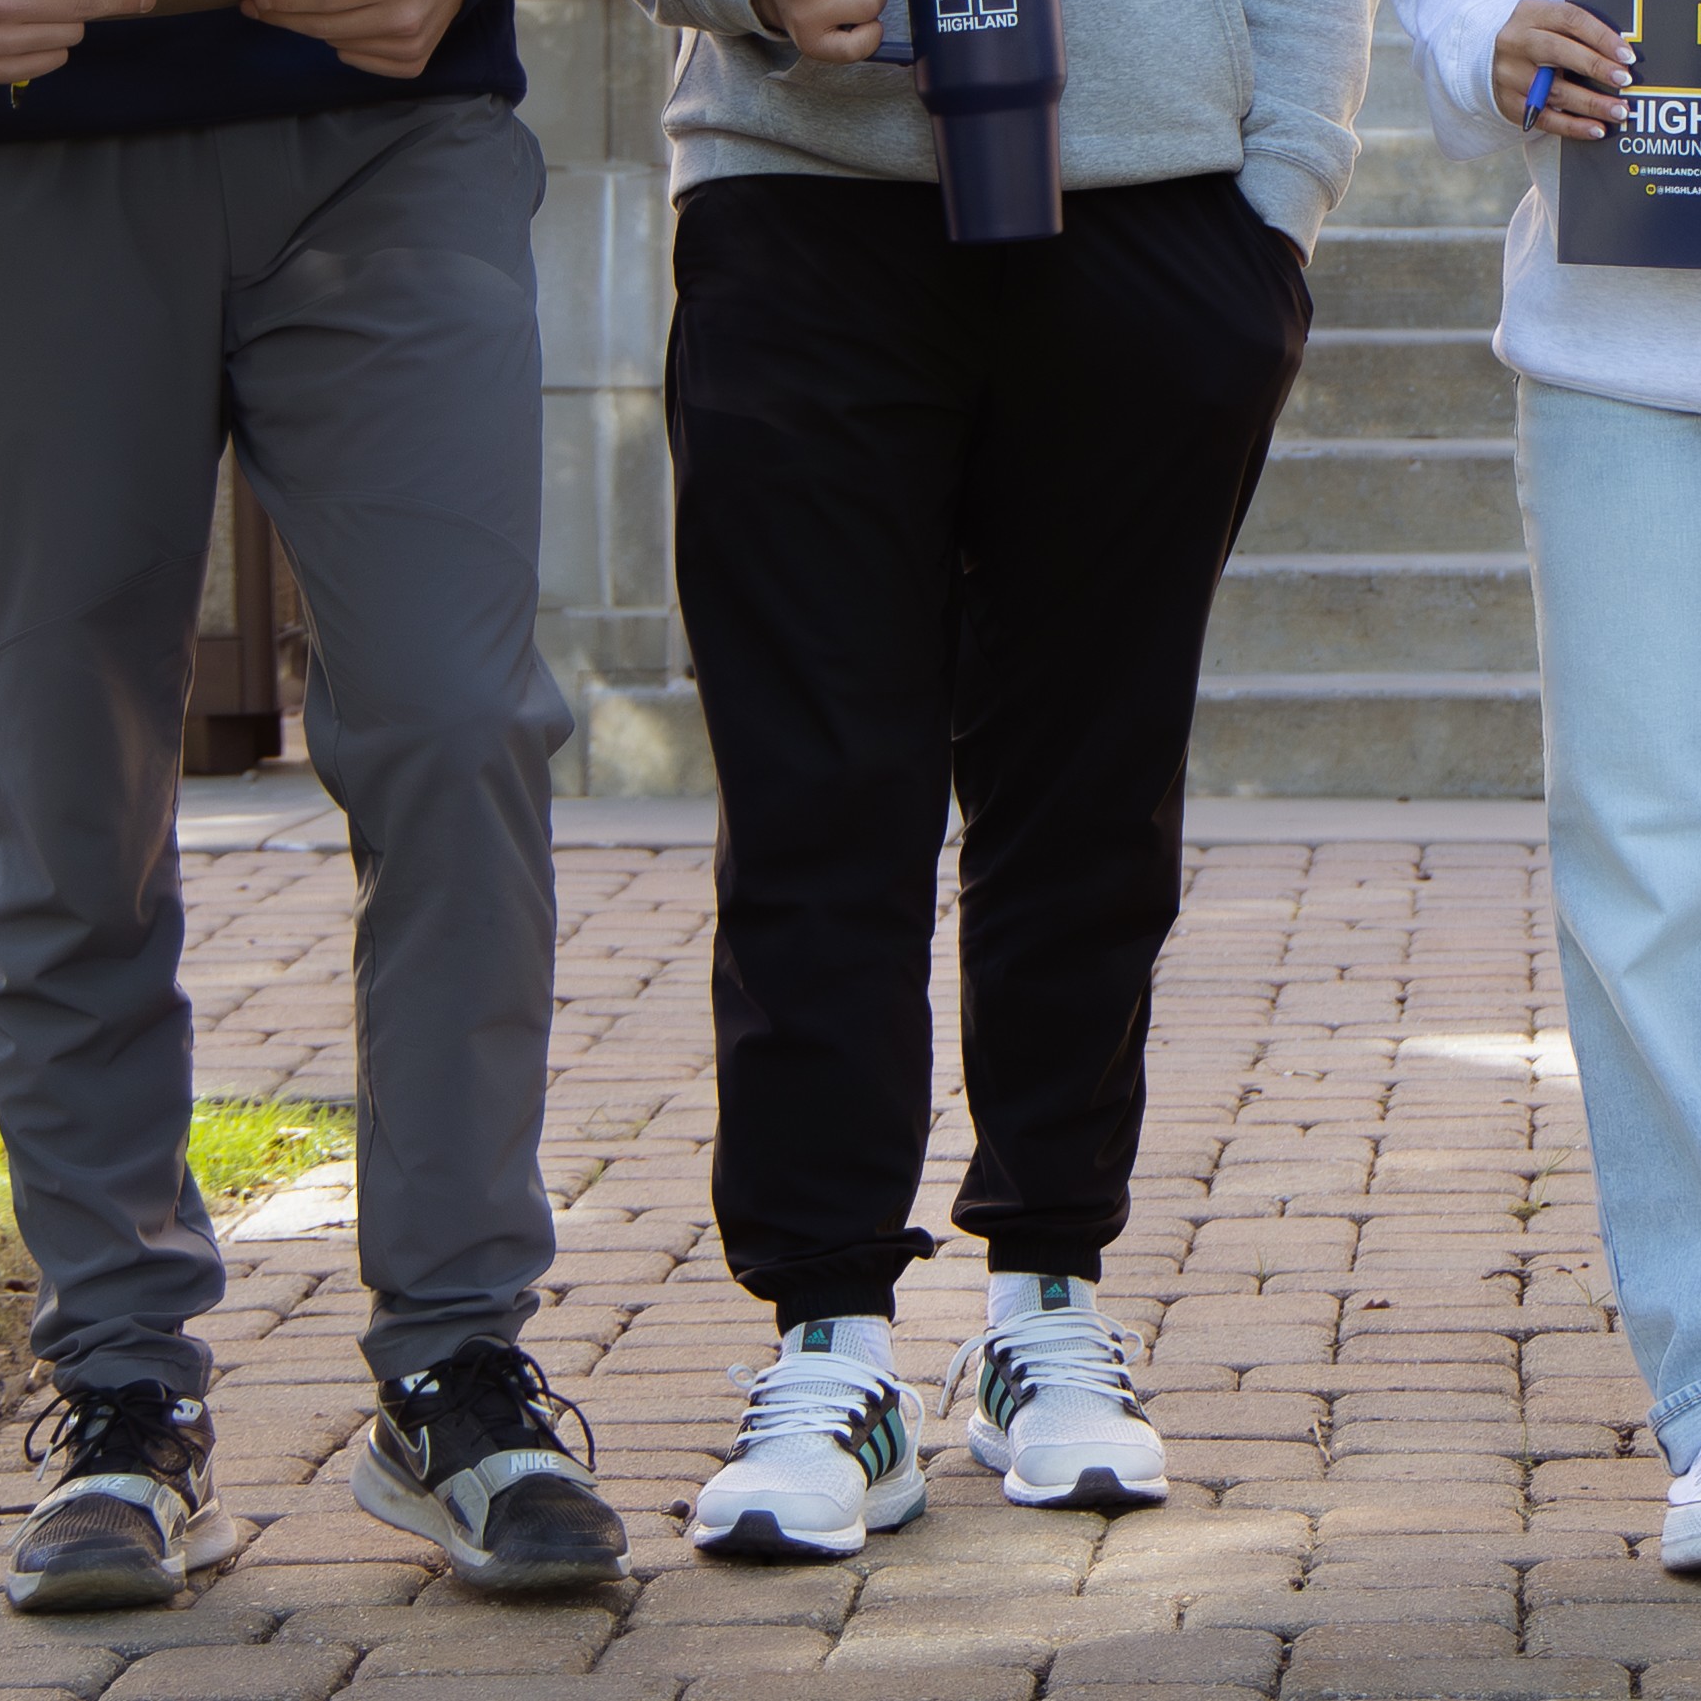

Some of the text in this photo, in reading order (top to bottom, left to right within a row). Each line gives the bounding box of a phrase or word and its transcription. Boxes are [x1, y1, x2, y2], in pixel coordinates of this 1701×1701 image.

[937, 13, 1019, 33] HIGHLAND
[510, 1452, 560, 1475] NIKE
[69, 1475, 132, 1492] NIKE
